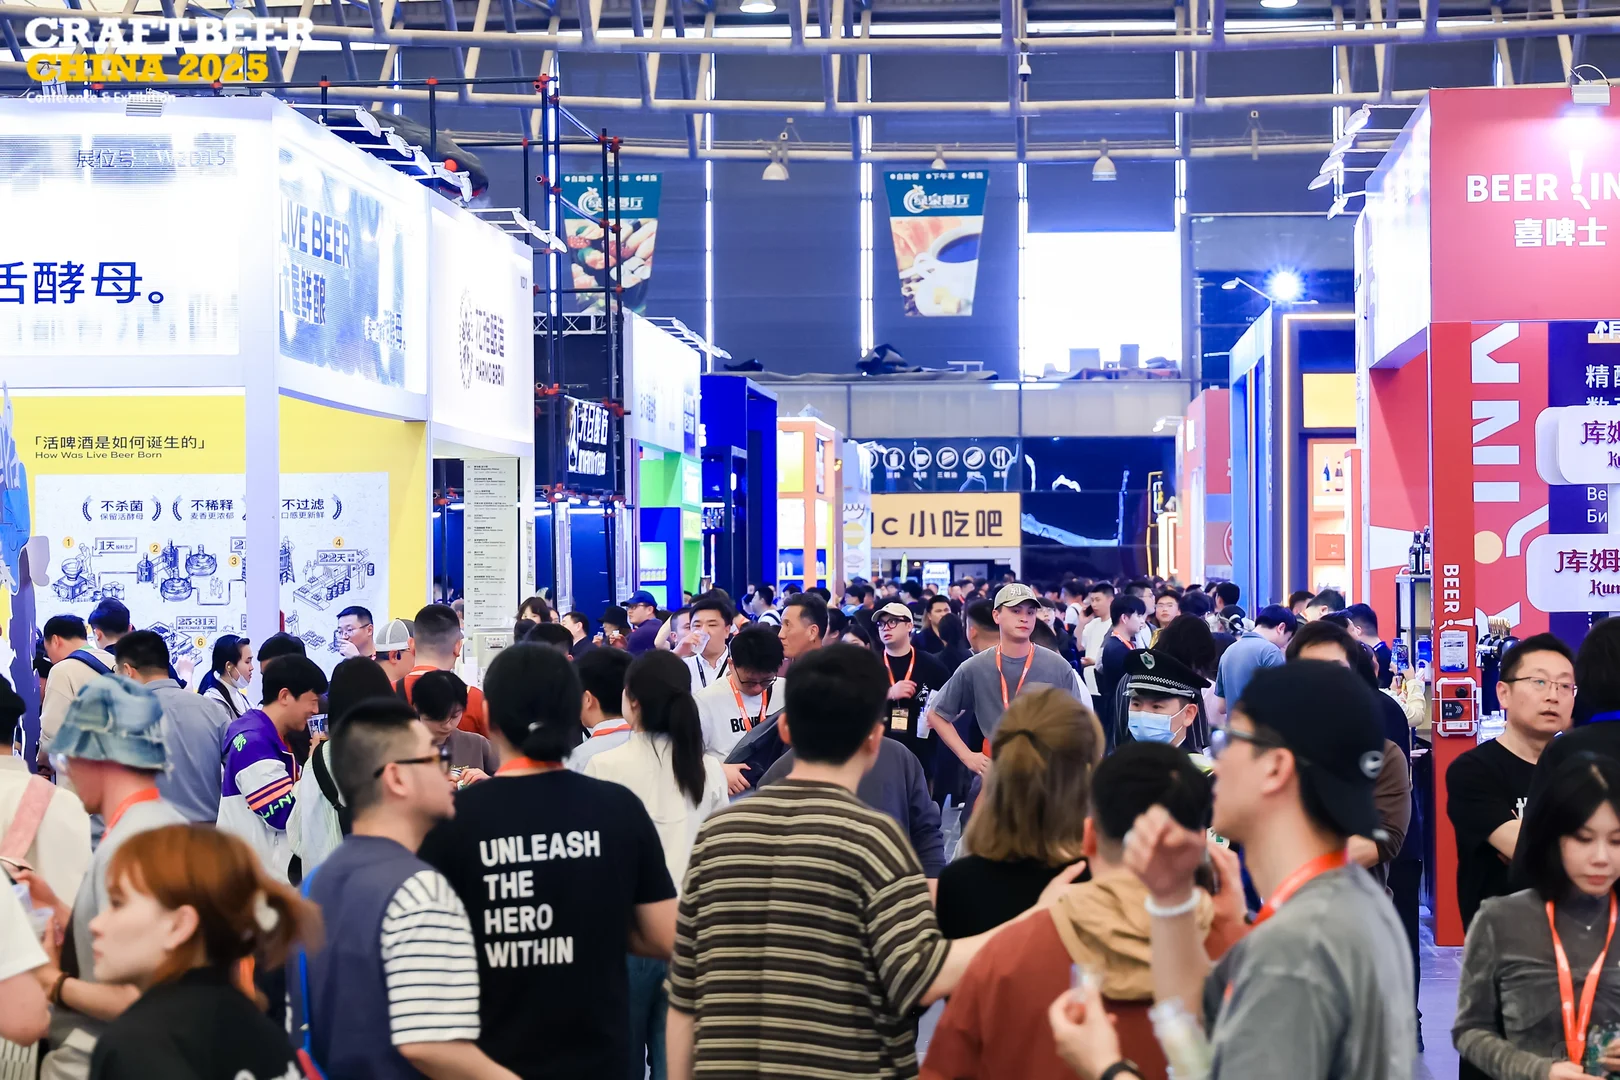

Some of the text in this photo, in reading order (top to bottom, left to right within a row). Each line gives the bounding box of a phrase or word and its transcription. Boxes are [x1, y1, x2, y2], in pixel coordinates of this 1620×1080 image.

[280, 196, 351, 268] LIVE BEER
[1513, 217, 1607, 247] 喜啤士
[35, 435, 206, 450] 「活啤酒是如何诞生的」
[35, 451, 162, 459] How Was Live Beer Born
[101, 500, 143, 512] 不杀菌
[190, 499, 234, 511] 不稀释
[281, 498, 324, 511] 不过滤
[909, 510, 1003, 538] 小吃吧
[479, 830, 601, 867] UNLEASH
[483, 870, 534, 901] THE
[484, 903, 553, 935] HERO
[484, 936, 574, 968] WITHIN
